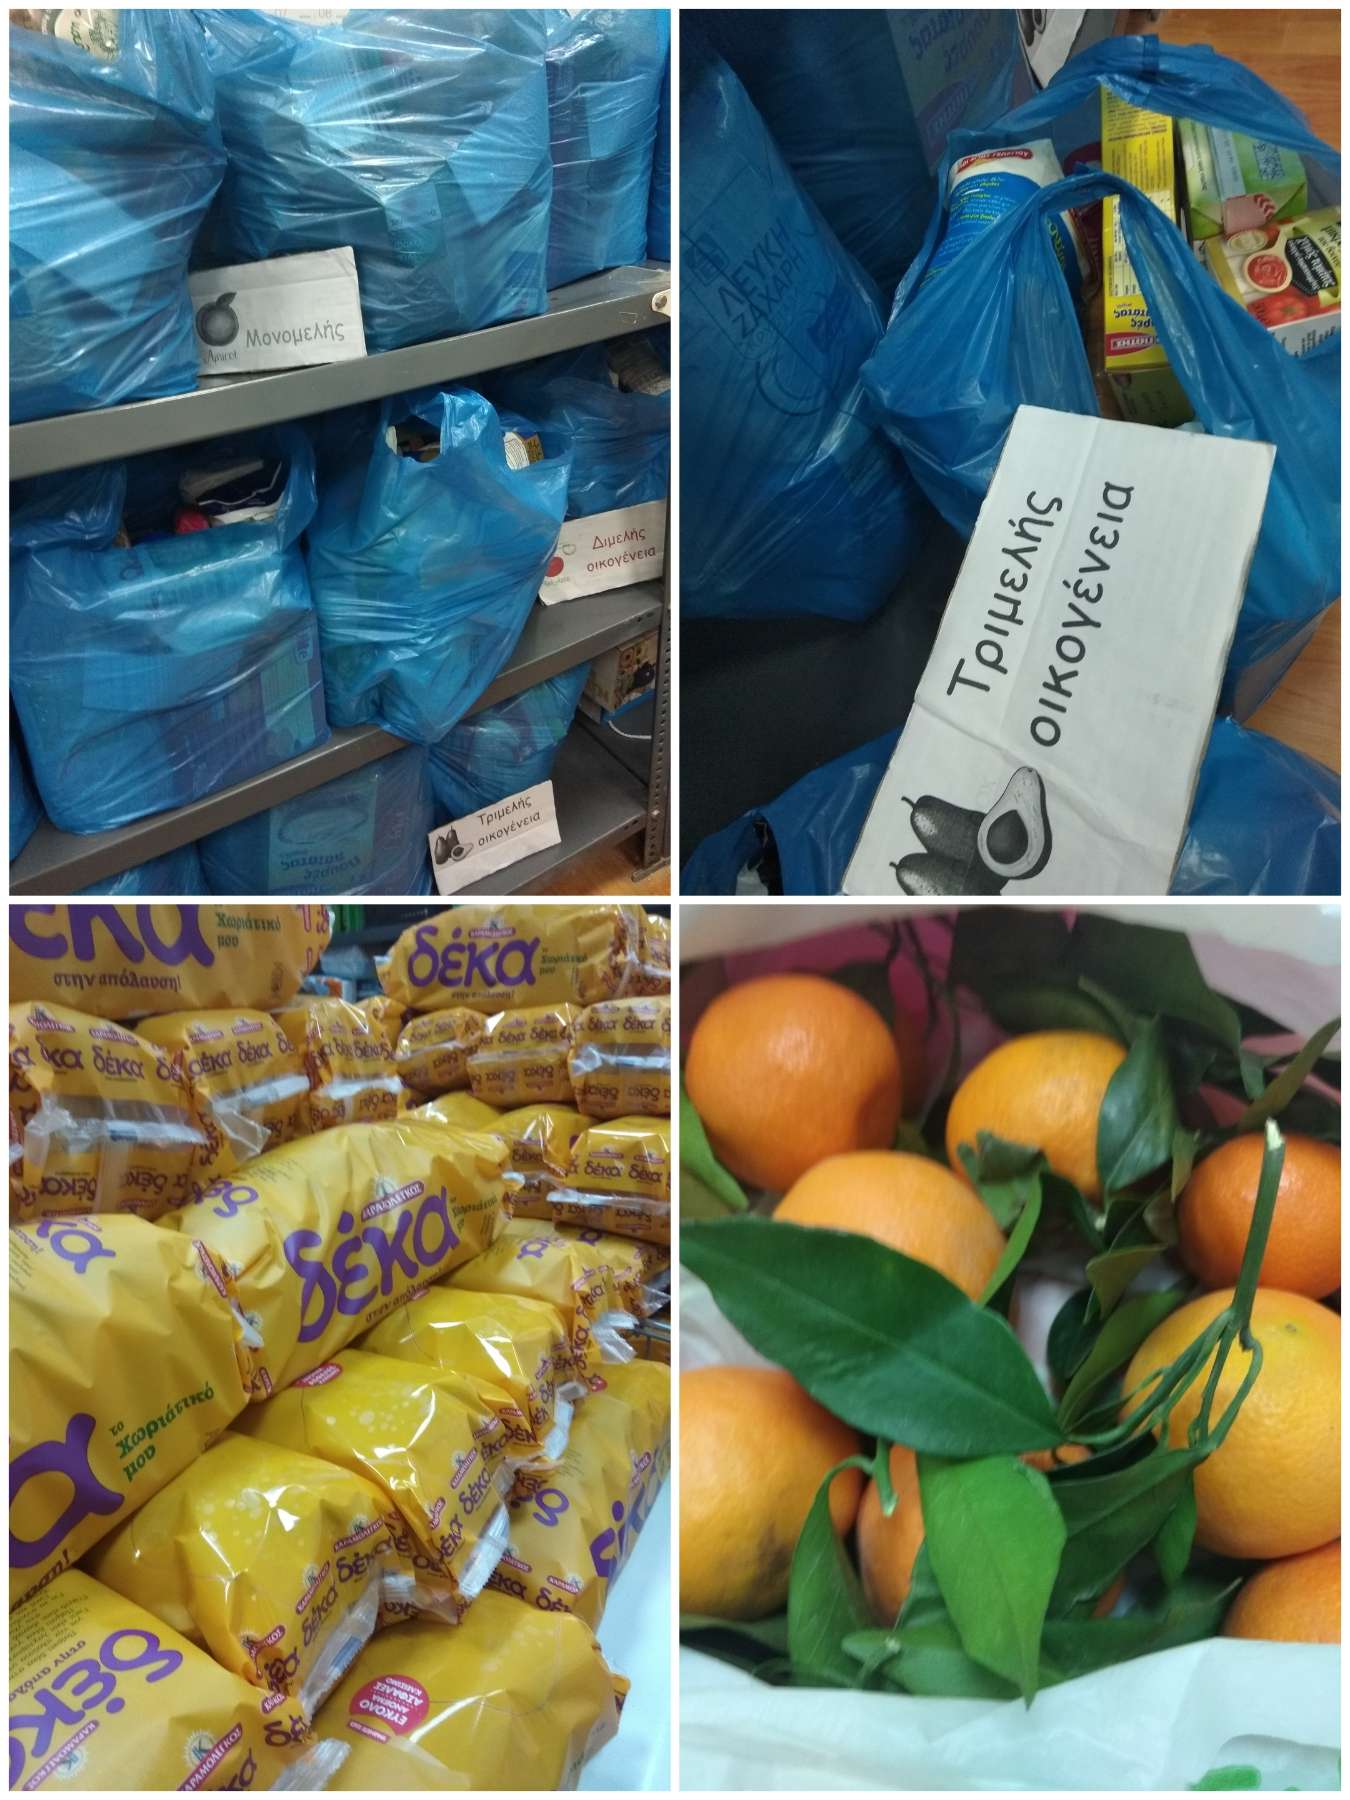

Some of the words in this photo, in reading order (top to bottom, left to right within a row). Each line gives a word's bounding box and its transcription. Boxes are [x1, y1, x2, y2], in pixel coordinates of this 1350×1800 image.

[718, 217, 791, 317] ΛΕΥΚΗ
[246, 320, 345, 349] Μονομελής
[592, 528, 646, 550] Διμελής
[587, 547, 657, 572] οικογένεια
[946, 490, 1063, 695] Τριμελής
[1030, 481, 1135, 747] οικογένεια
[478, 796, 532, 825] Τριμελής
[478, 812, 541, 846] οικογένεια
[217, 935, 239, 950] μου
[407, 925, 541, 988] δέκα
[54, 973, 96, 988] στην
[99, 970, 182, 993] απόλαυση!
[623, 1016, 656, 1031] δέκα
[92, 1044, 145, 1079] δέκα
[237, 1040, 273, 1063] δέκα
[584, 1161, 622, 1177] δέκα
[628, 1164, 663, 1182] δέκα
[283, 1185, 460, 1344] δέκα
[109, 1420, 125, 1437] το
[122, 1445, 157, 1483] μου
[459, 1467, 493, 1515] δέκα
[302, 1581, 338, 1647] δέκα
[54, 1640, 87, 1668] στην
[359, 1699, 408, 1726] ΕΥΚΟΛΟ
[183, 1726, 242, 1791] ΑΡΑΜΟΛΕΓΚΟΣ
